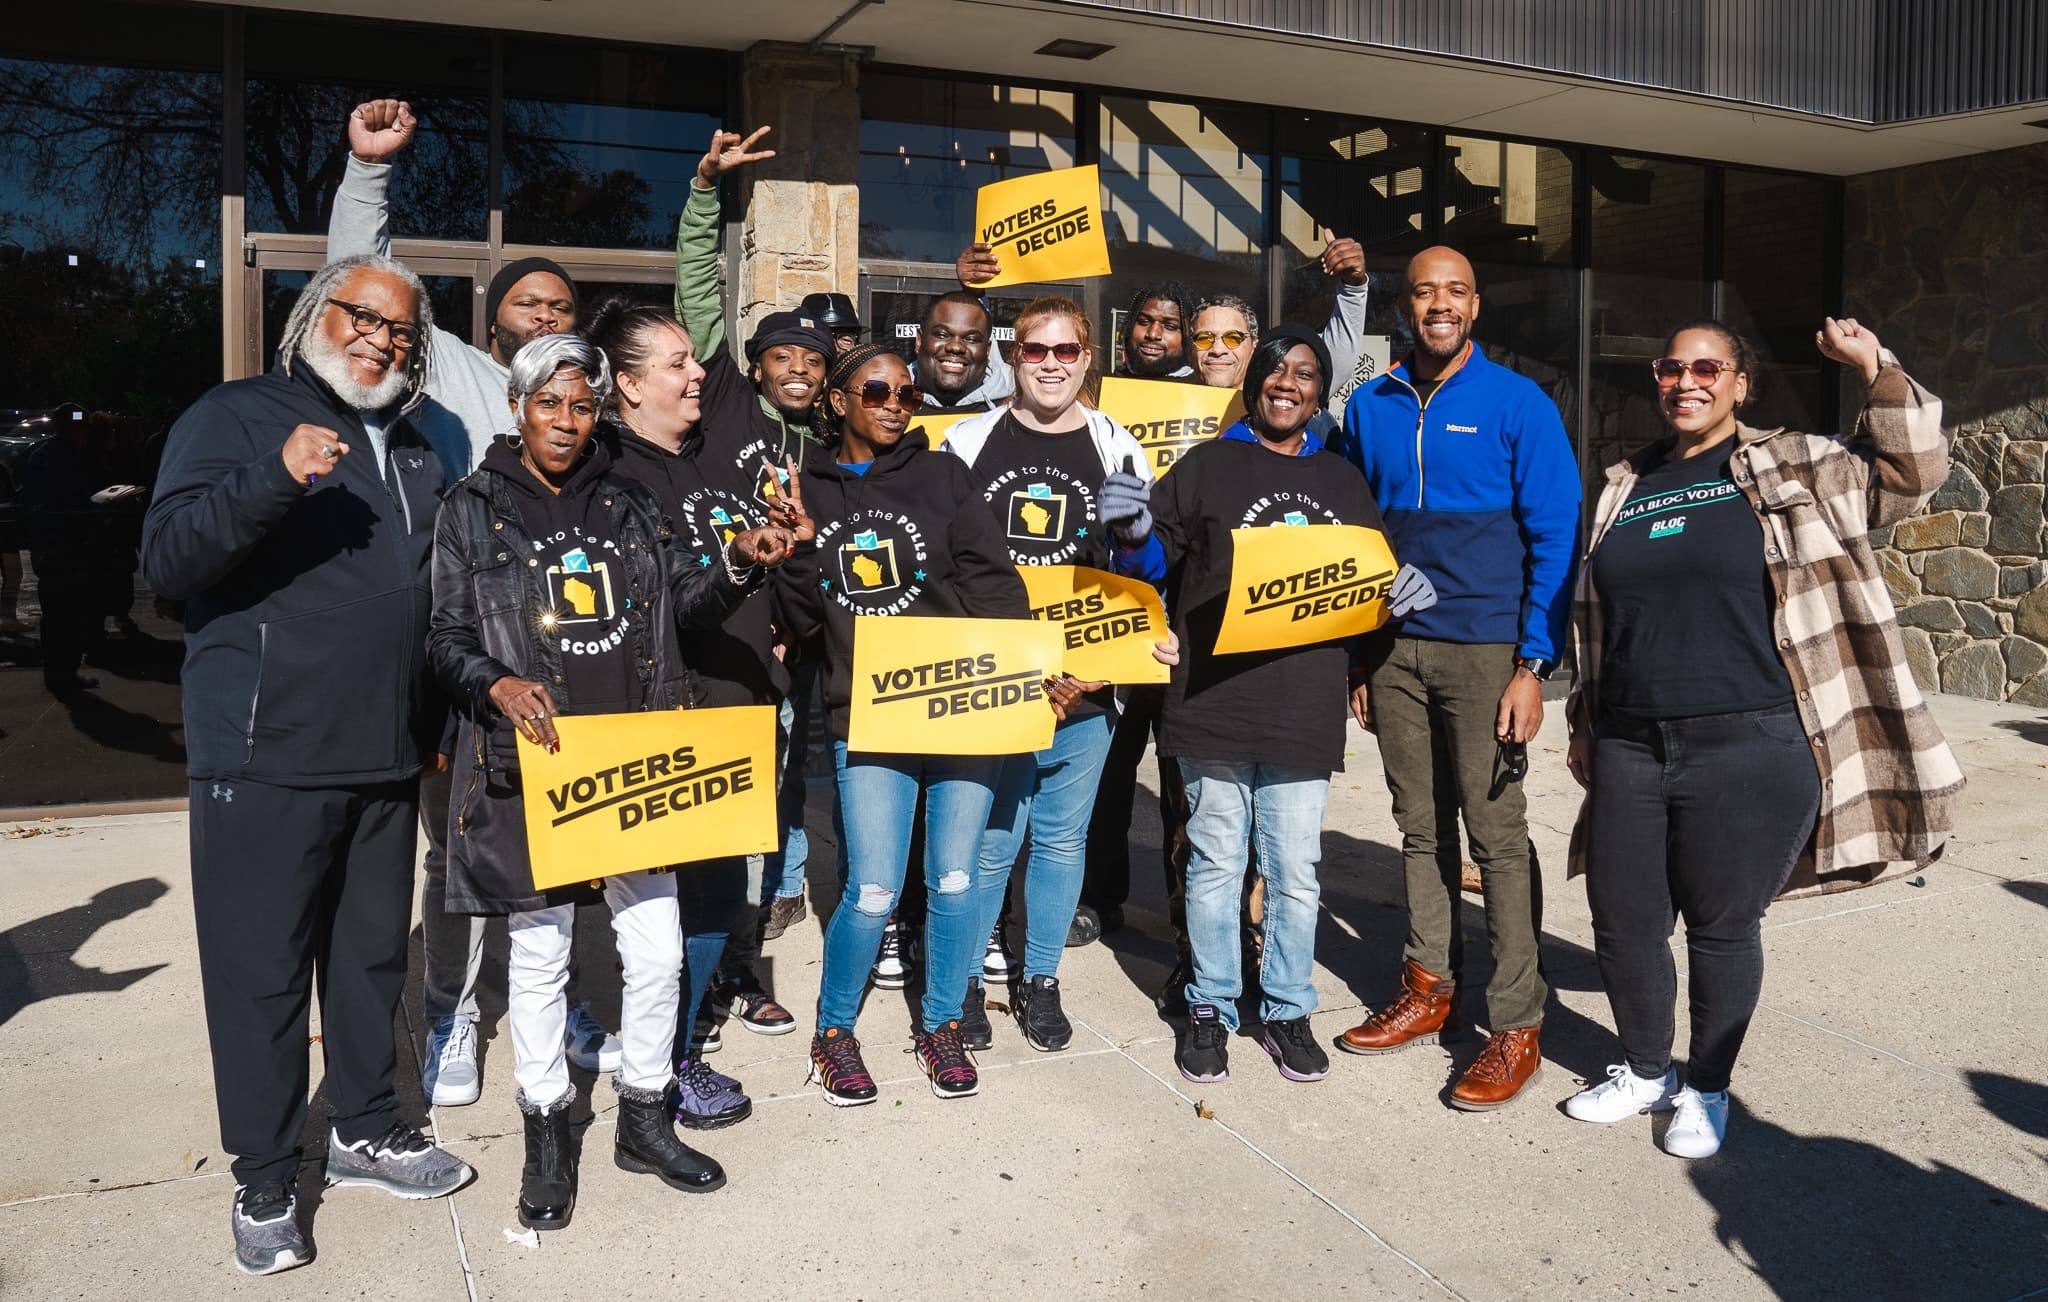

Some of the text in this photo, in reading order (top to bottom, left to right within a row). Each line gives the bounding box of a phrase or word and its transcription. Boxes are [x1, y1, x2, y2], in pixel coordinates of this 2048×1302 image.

[982, 199, 1056, 243] VOTERS
[1016, 213, 1091, 257] DECIDE
[992, 328, 1014, 339] RIVE
[735, 439, 766, 468] POWE
[983, 466, 1097, 522] OWER to the POLLS
[1239, 491, 1320, 529] OWER to the
[1635, 505, 1645, 514] A
[1647, 493, 1684, 511] BLOC
[1686, 483, 1737, 500] VOTER
[573, 526, 597, 544] te
[816, 520, 842, 548] WER
[867, 509, 894, 521] the
[896, 515, 927, 561] POLLS
[1651, 516, 1687, 531] BLOC
[1007, 542, 1078, 566] SCONSIN
[1247, 557, 1358, 605] VOTERS
[836, 585, 922, 617] WISCONSIN
[1031, 593, 1104, 620] TERS
[1291, 580, 1394, 622] DECIDE
[560, 616, 630, 655] SCONSIN
[1064, 614, 1151, 650] ECIDE
[871, 653, 997, 694] VOTERS
[928, 678, 1043, 720] DECIDE
[546, 746, 697, 813] VOTERS
[618, 767, 754, 831] DECIDE
